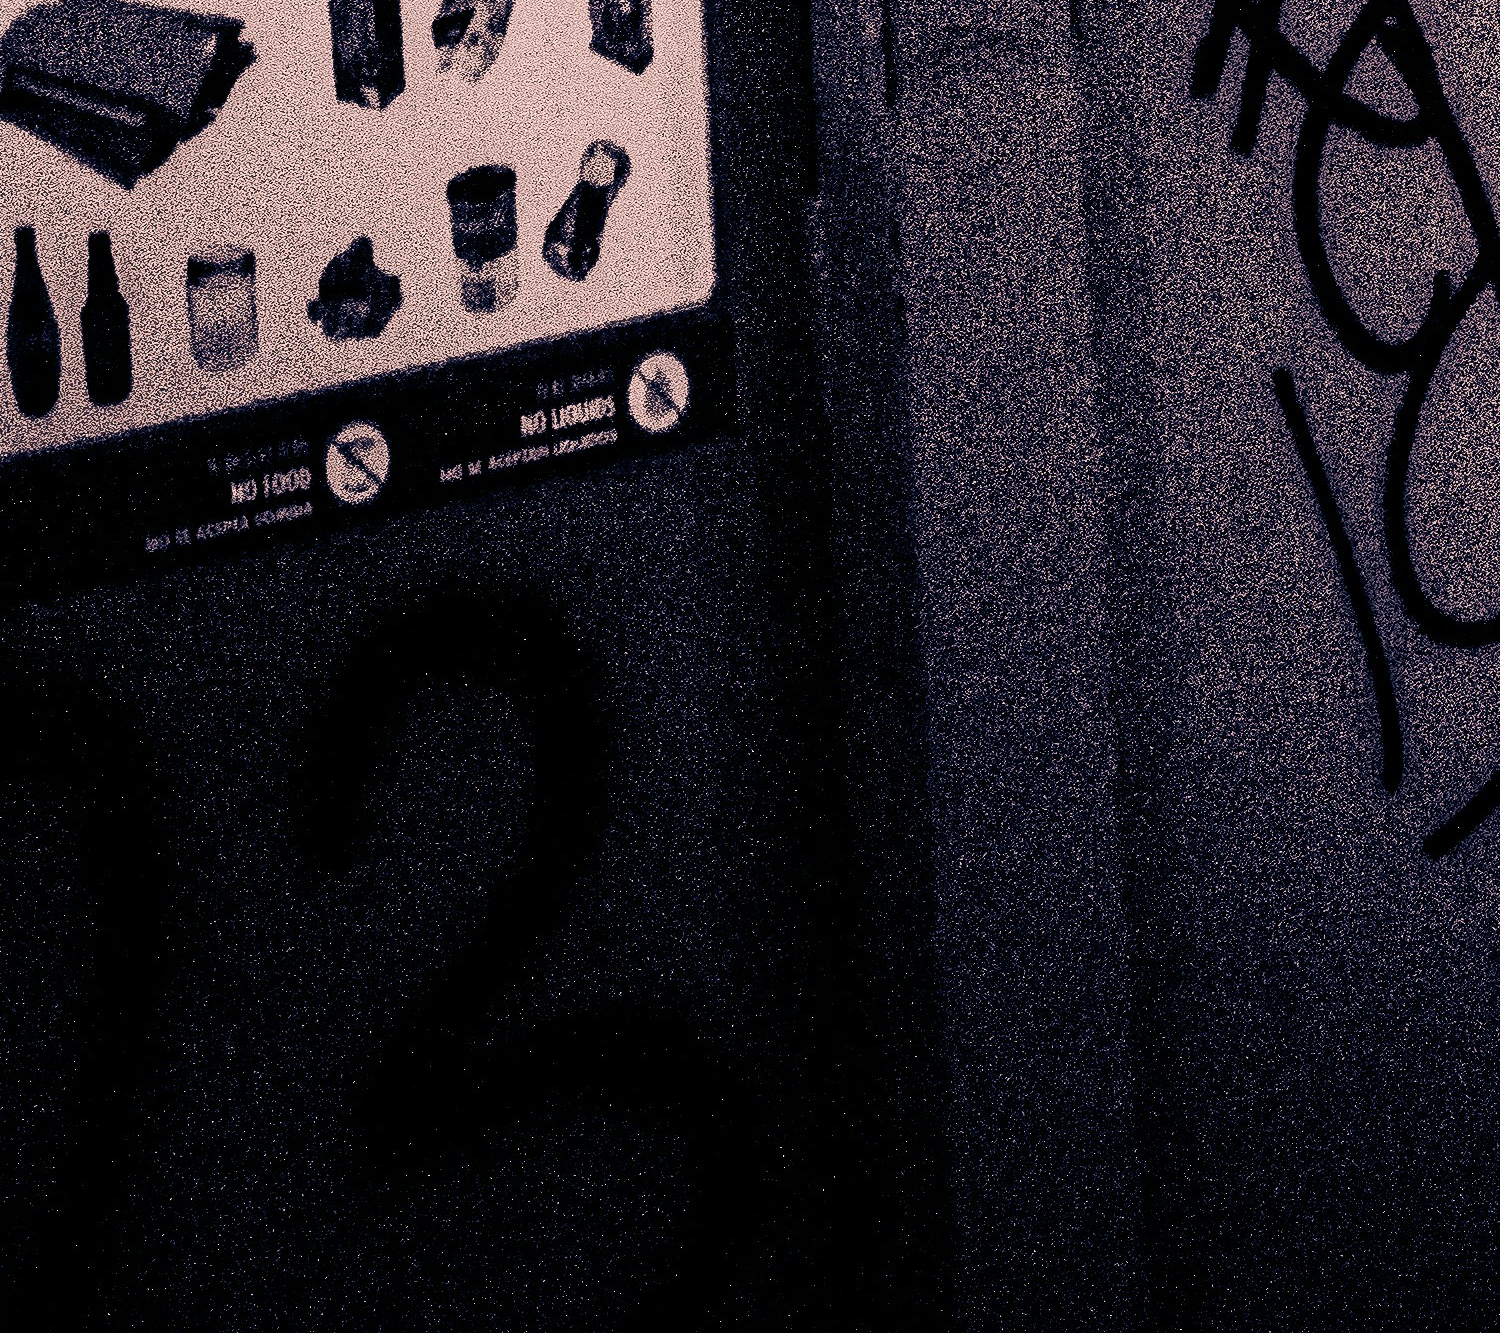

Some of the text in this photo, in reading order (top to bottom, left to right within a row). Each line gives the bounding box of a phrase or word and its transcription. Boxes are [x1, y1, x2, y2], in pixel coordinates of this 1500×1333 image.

[520, 395, 616, 438] NO LIQUIDS
[231, 465, 312, 504] NO FOOD
